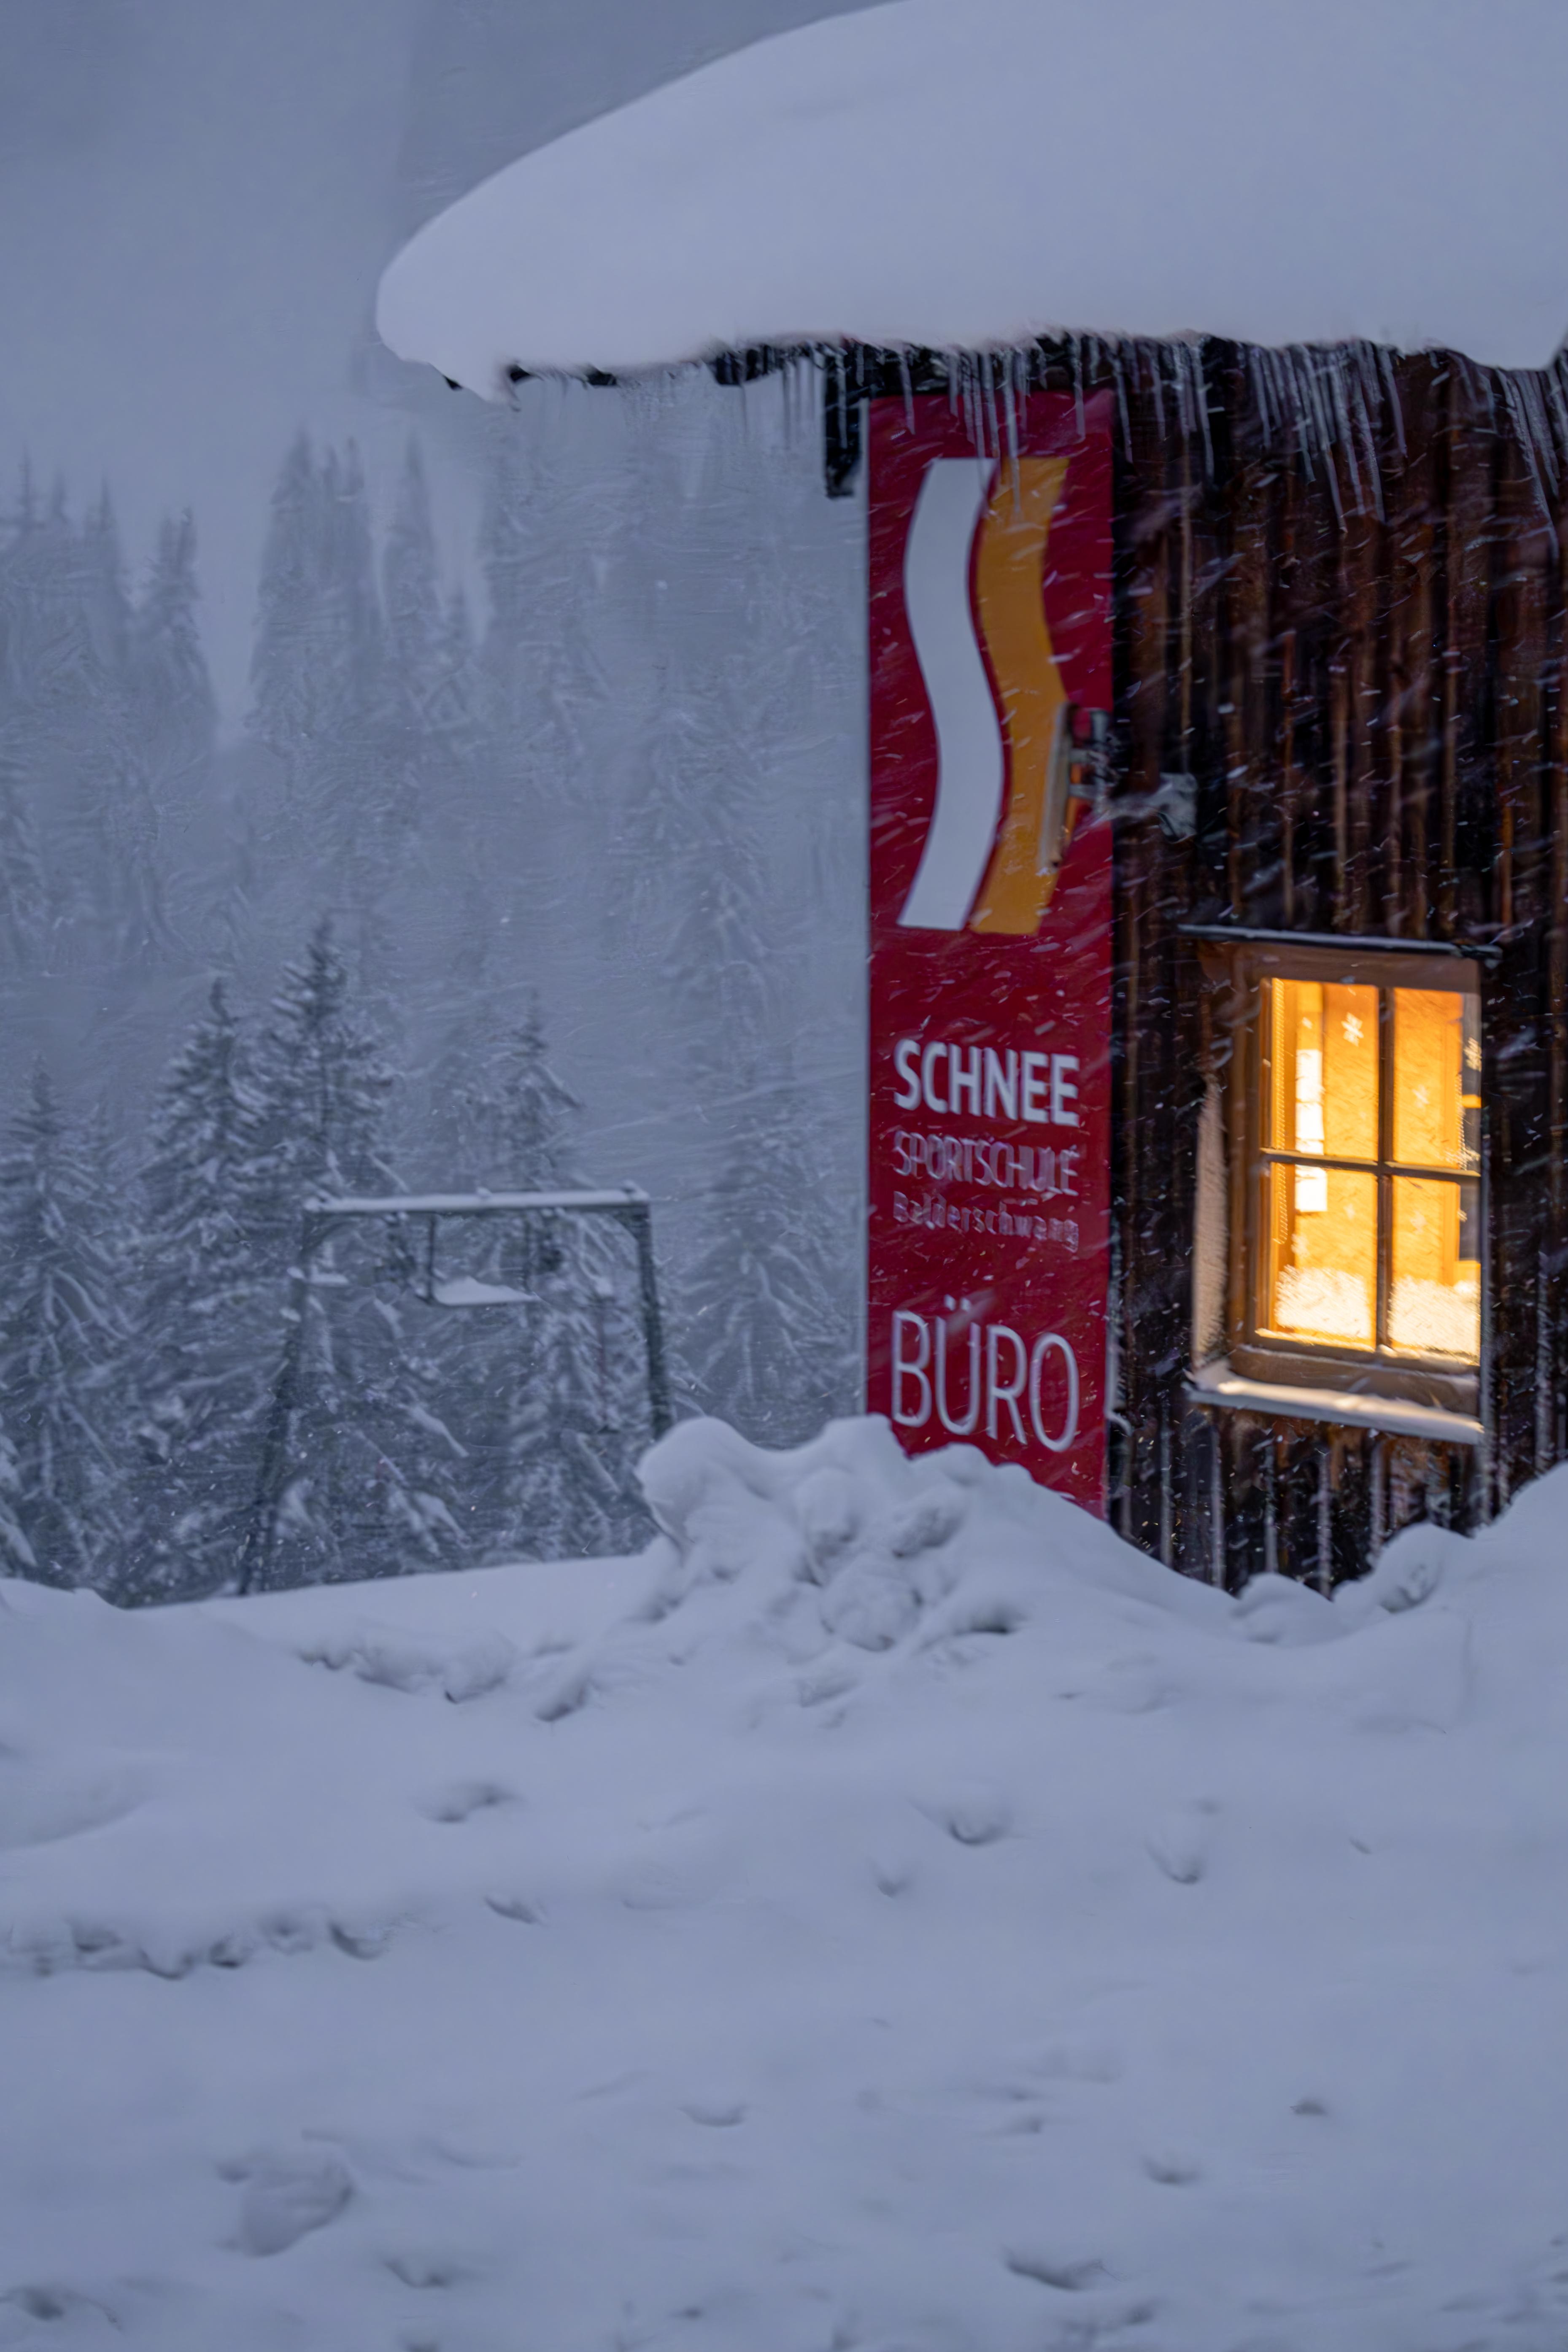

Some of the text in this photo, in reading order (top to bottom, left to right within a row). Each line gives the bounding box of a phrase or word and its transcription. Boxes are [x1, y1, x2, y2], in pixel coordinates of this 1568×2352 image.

[893, 1039, 1080, 1127] SCHNEE
[893, 1130, 1079, 1196] SPORTSCHULE
[892, 1294, 1080, 1451] BÜRO
